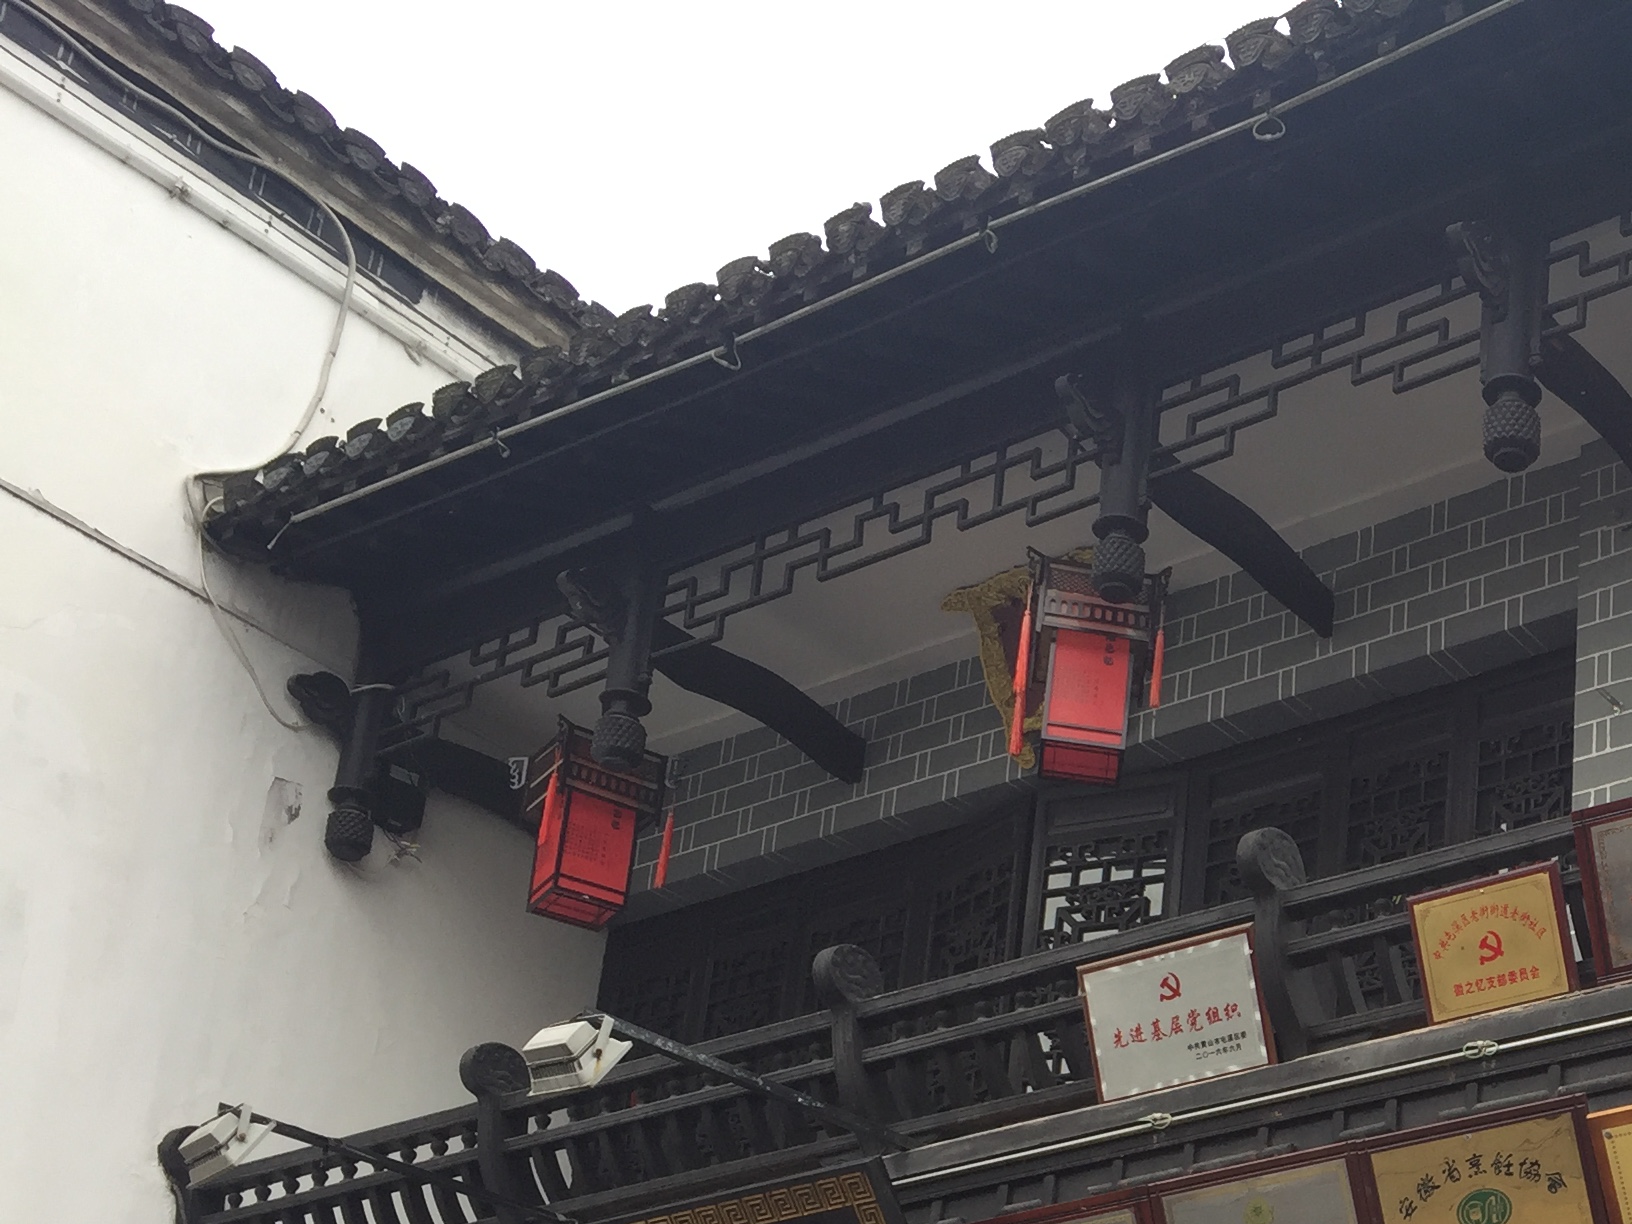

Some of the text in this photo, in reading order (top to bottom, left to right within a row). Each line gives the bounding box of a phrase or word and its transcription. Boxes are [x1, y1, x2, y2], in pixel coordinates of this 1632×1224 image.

[1113, 1002, 1242, 1049] 先进基层党组织
